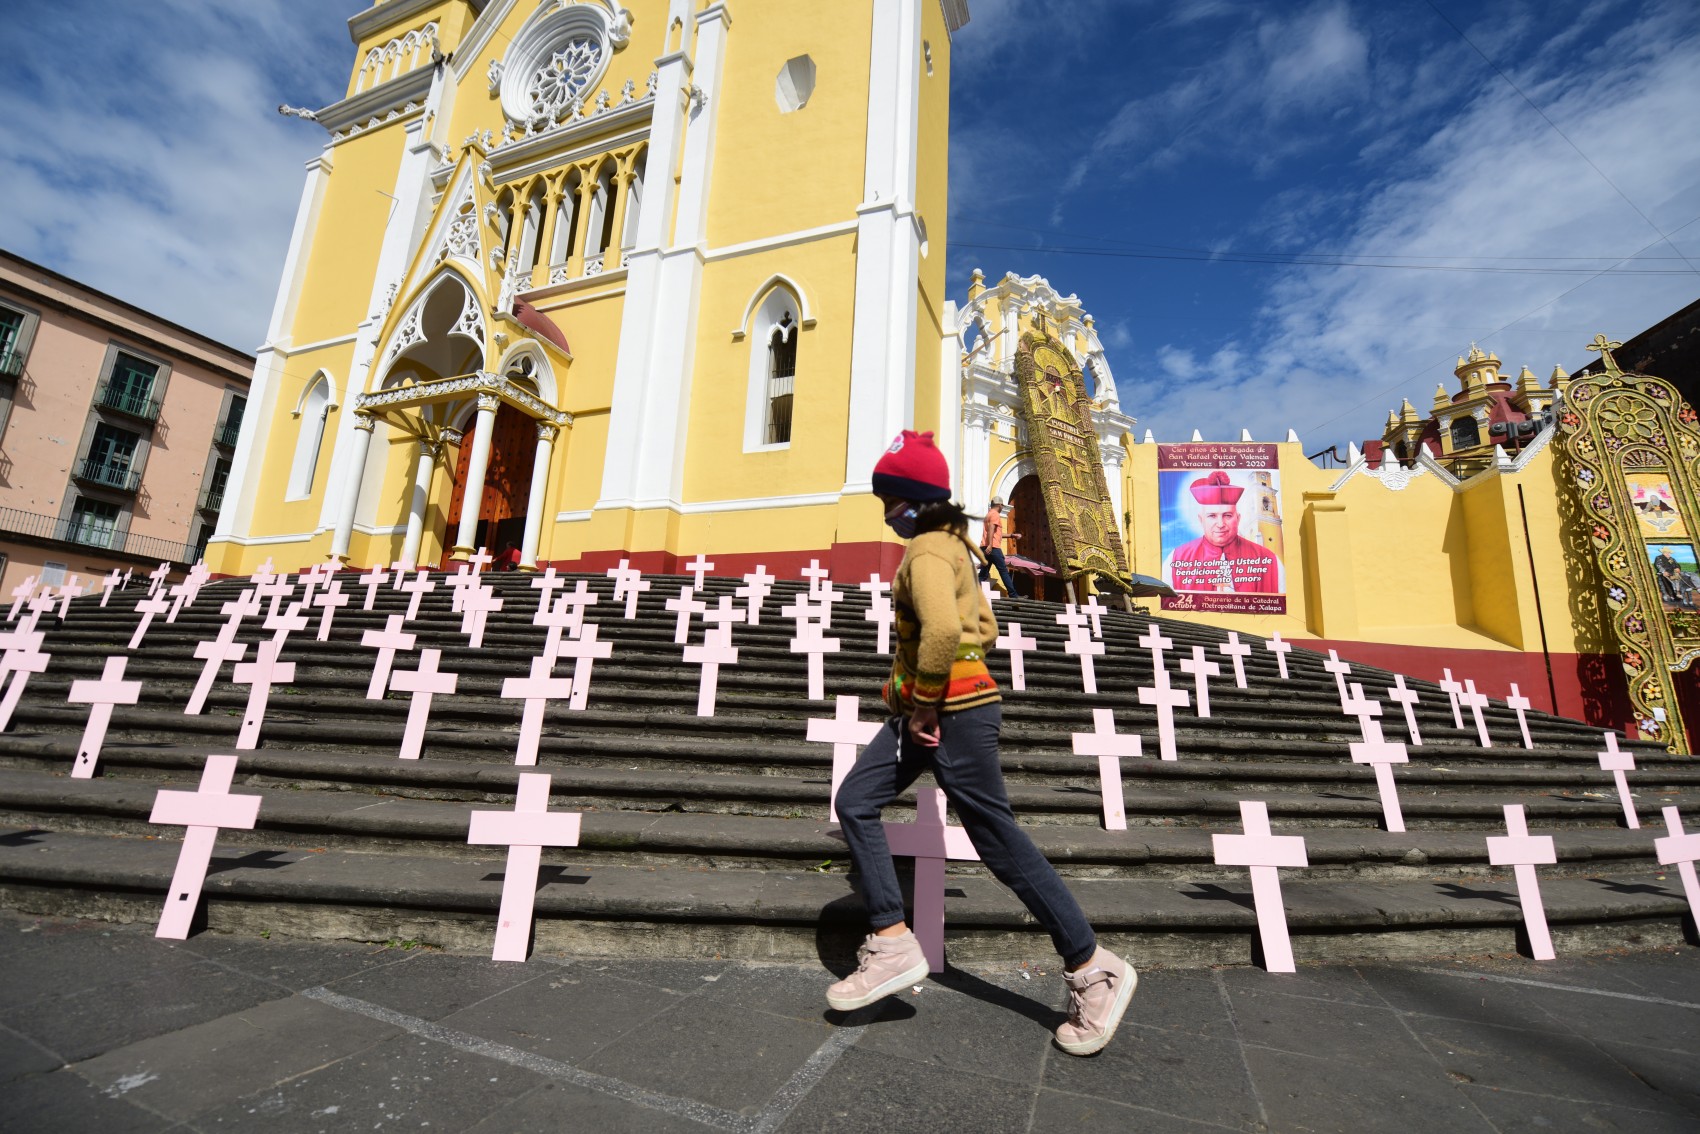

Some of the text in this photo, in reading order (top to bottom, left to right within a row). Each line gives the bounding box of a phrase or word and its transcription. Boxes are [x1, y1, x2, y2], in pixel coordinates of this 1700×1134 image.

[1237, 557, 1261, 566] Usted
[1176, 568, 1224, 576] bendiciones
[1182, 577, 1192, 585] de
[1177, 594, 1193, 604] 24
[1202, 602, 1246, 610] Metropolitana
